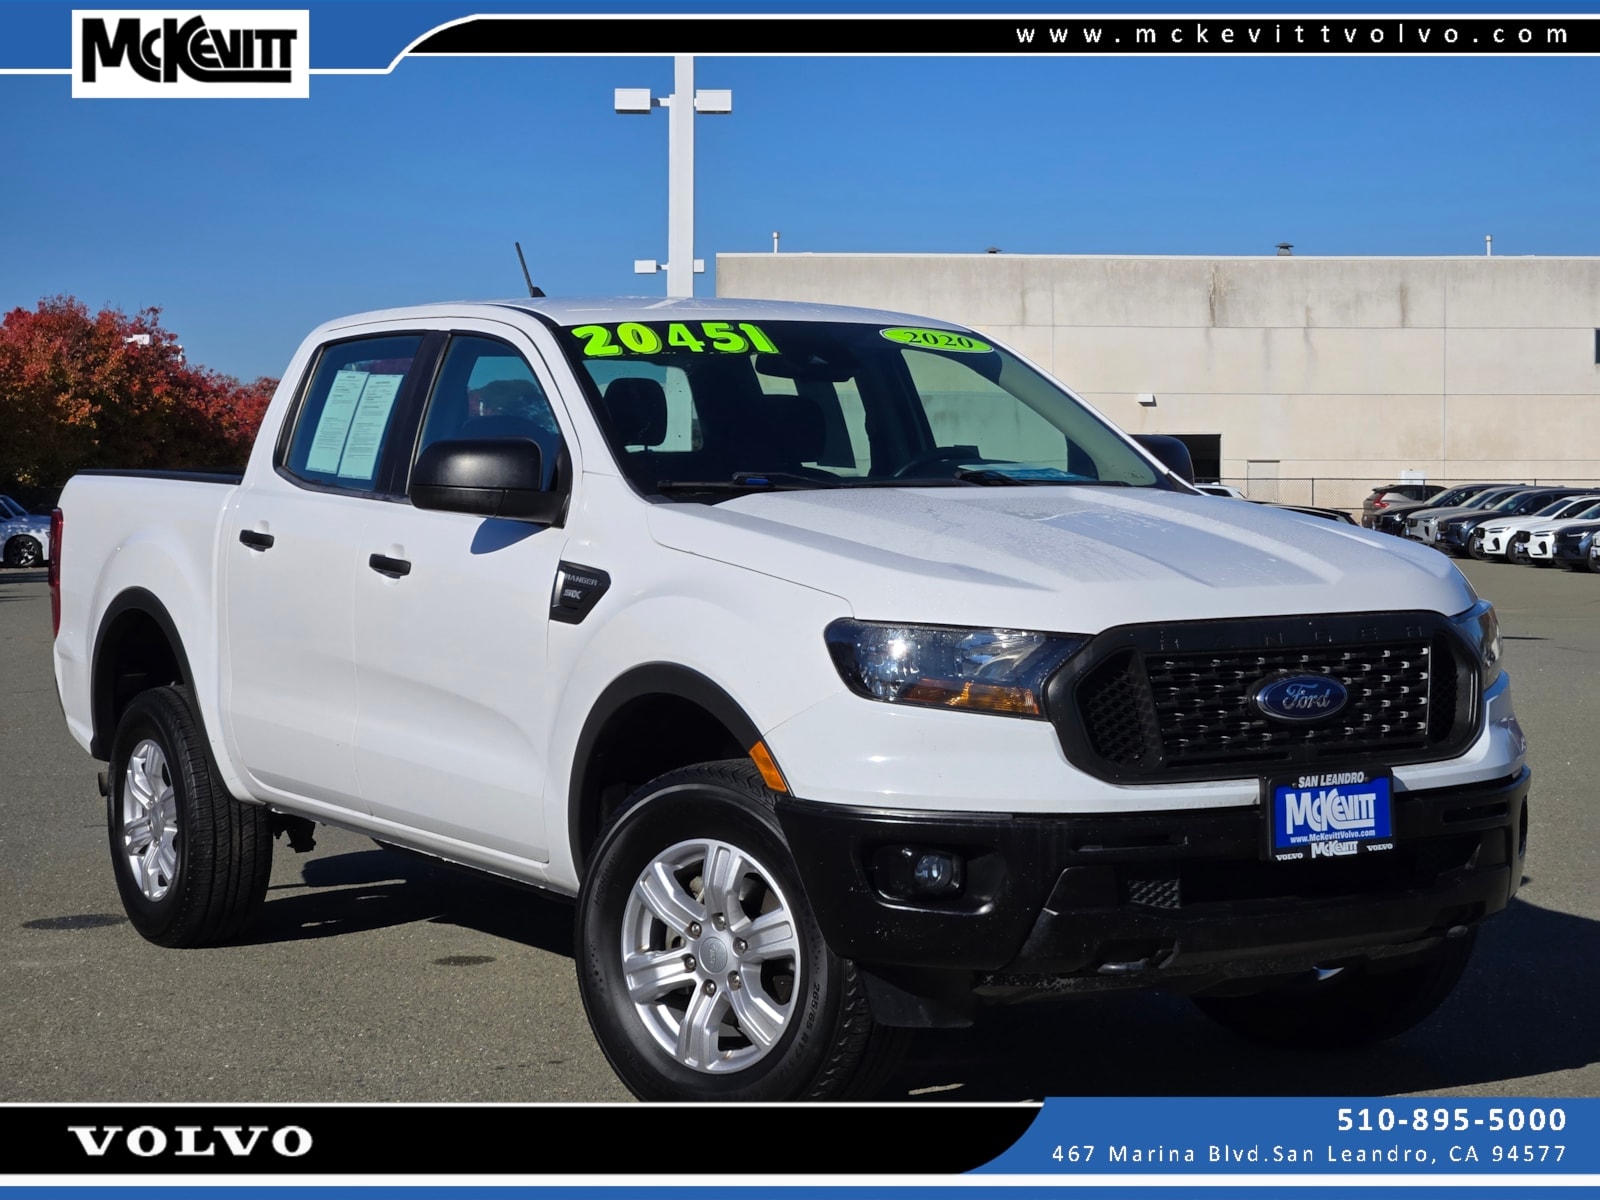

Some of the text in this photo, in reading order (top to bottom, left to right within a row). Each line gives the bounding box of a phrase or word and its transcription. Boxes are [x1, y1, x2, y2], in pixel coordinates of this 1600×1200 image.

[571, 321, 779, 356] 20451
[904, 331, 974, 349] 2020
[1283, 683, 1331, 710] Ford
[1298, 771, 1365, 789] SAN LEANDRO
[1290, 829, 1376, 844] www.McKevittVolvo.com
[1275, 852, 1304, 862] VOLVO
[1366, 842, 1393, 852] VOLVO
[806, 981, 821, 1031] 265/65
